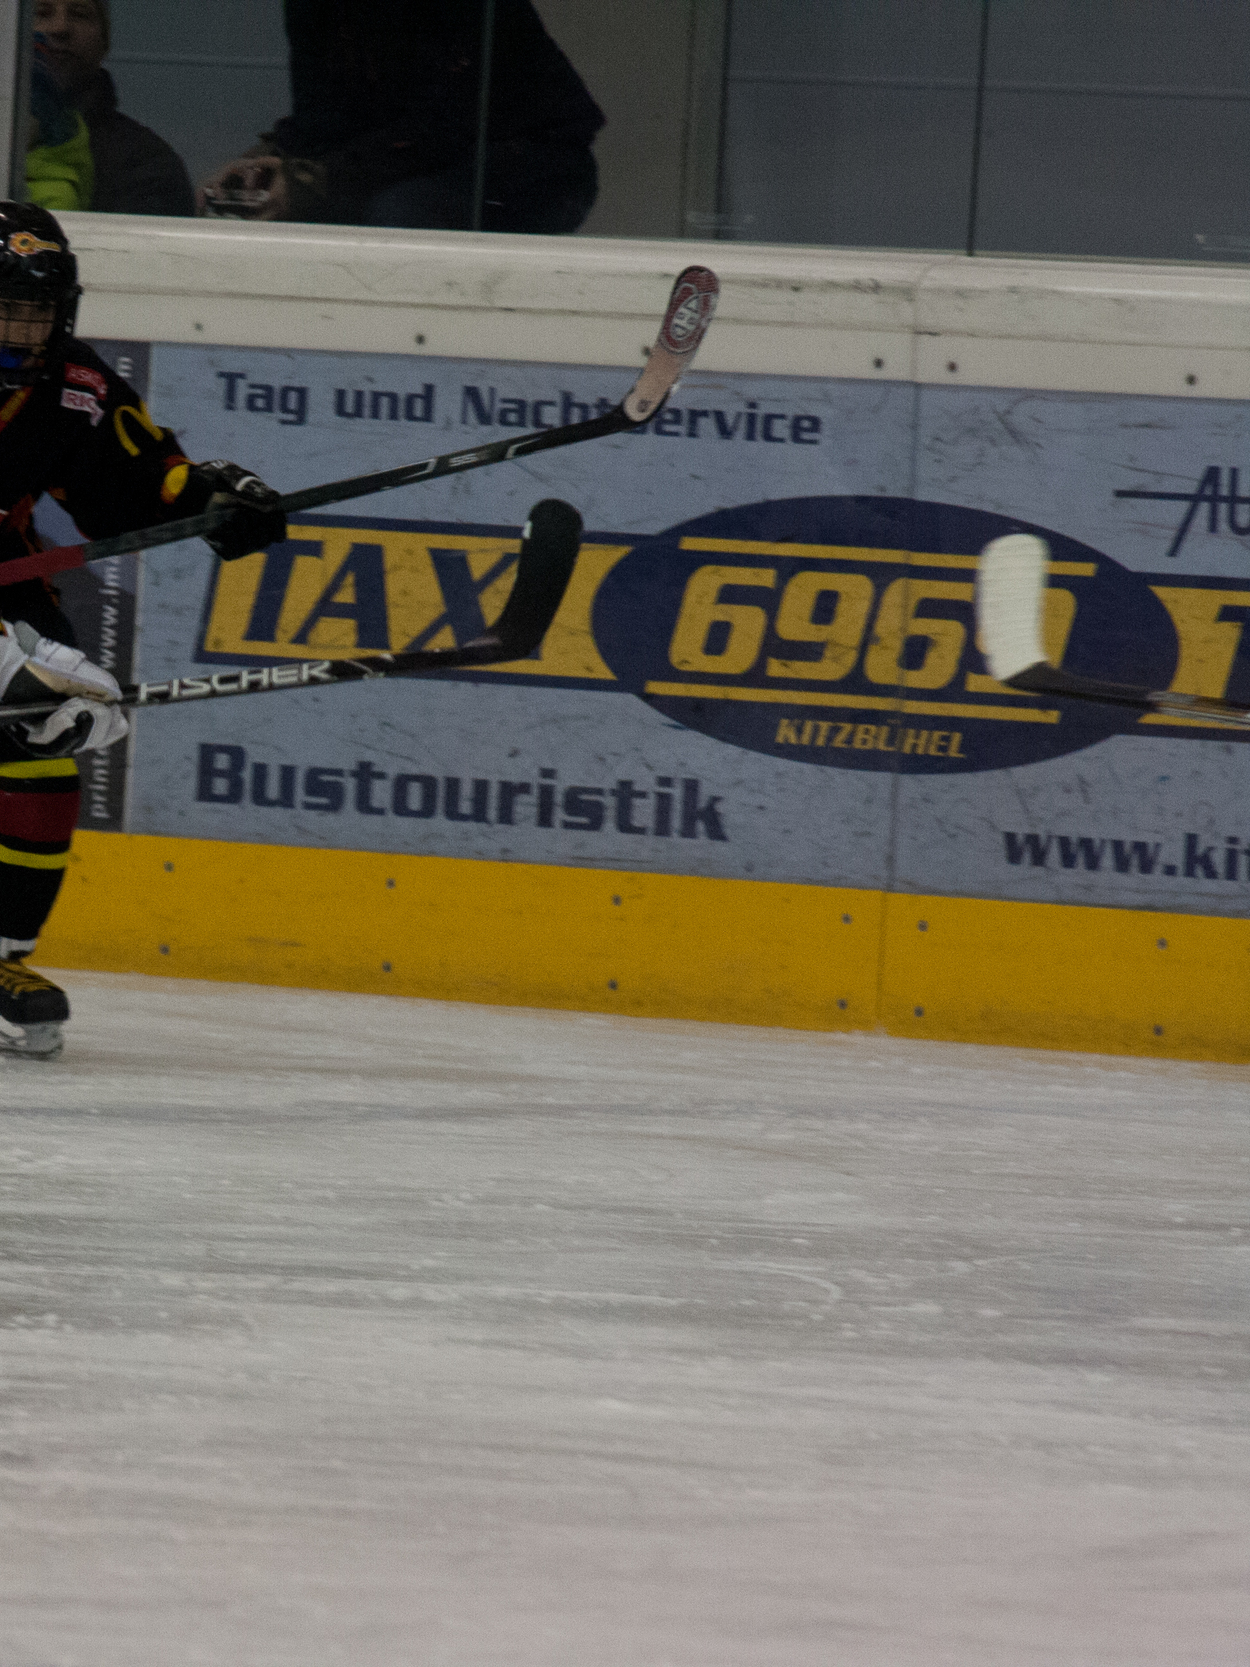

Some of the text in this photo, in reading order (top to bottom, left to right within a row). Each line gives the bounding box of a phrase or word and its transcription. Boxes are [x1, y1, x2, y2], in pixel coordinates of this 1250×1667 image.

[217, 371, 823, 446] Tag und Nachervice
[138, 659, 338, 702] FISCHER
[773, 718, 967, 758] KITZBÜHEL
[195, 742, 729, 842] Bustouristik
[1003, 831, 1250, 881] www.ki
